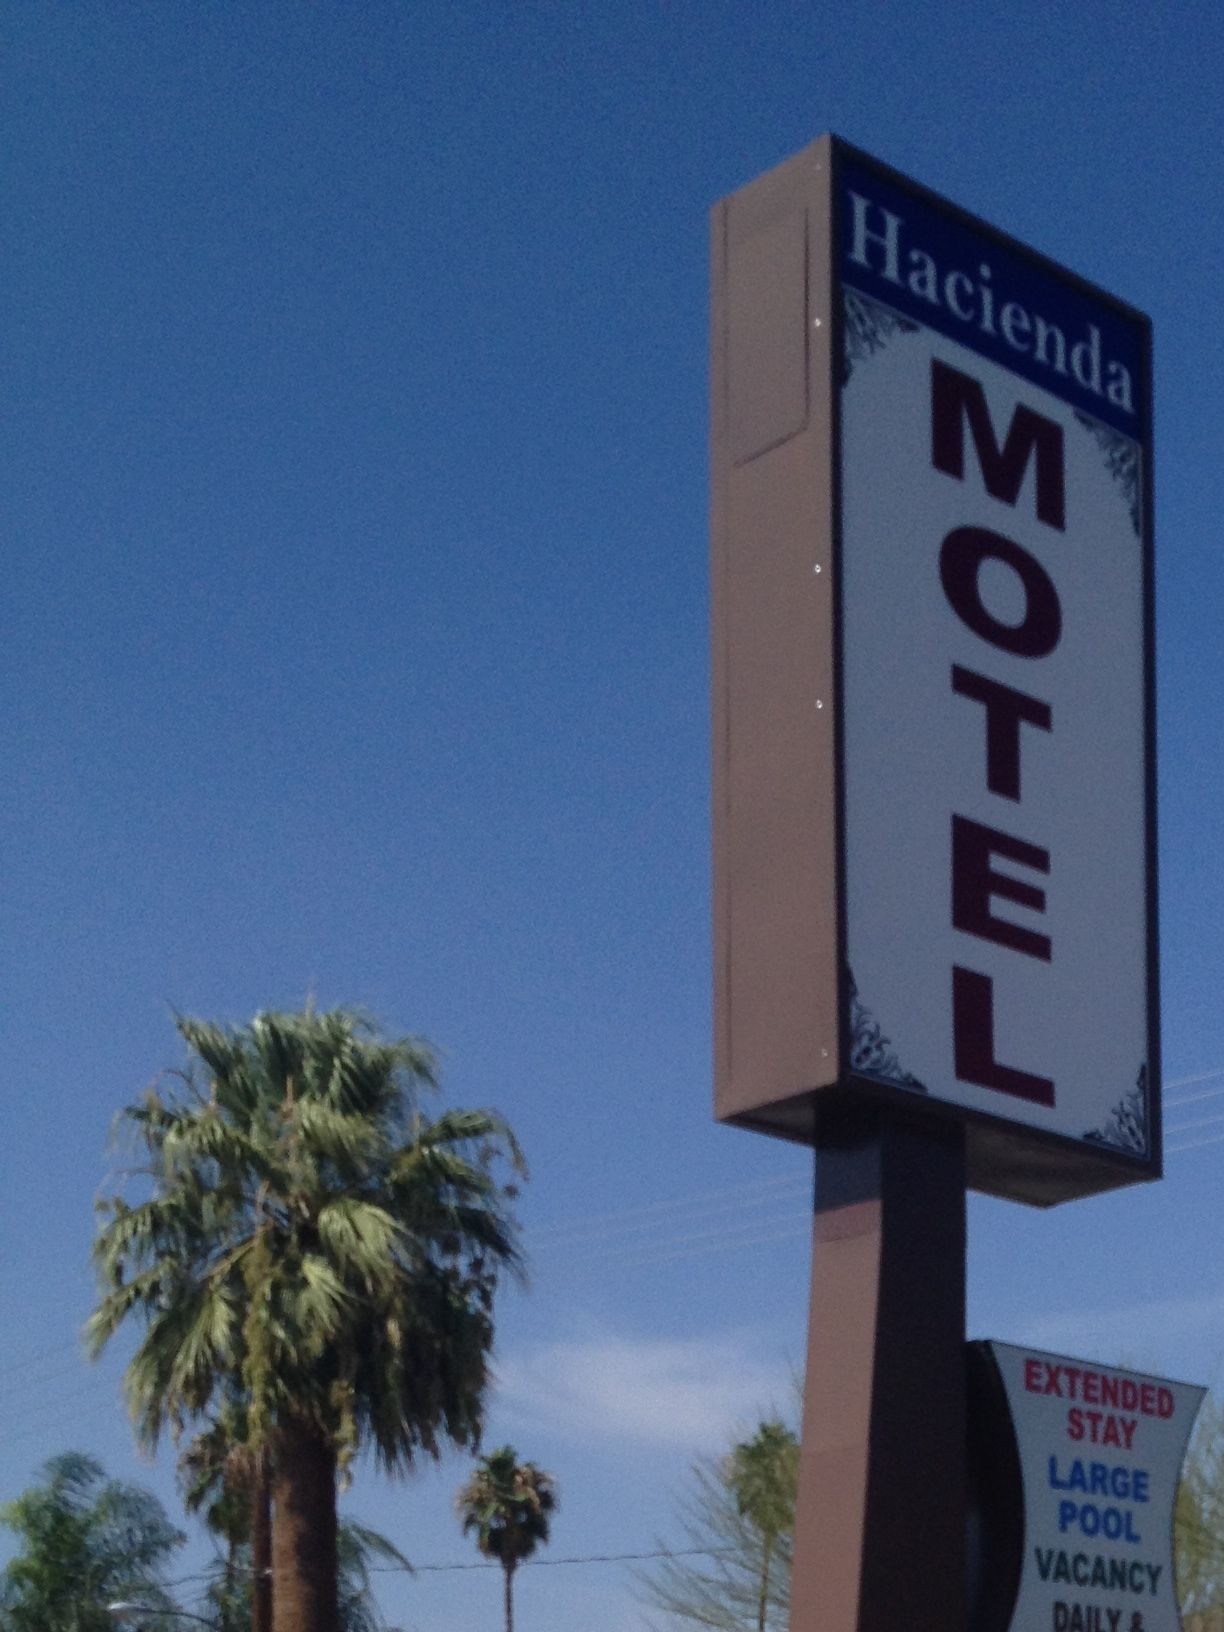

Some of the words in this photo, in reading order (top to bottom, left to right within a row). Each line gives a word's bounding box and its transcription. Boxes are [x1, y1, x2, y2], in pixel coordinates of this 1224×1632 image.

[848, 189, 1136, 415] Hacienda
[930, 356, 1066, 1108] MOTEL
[1024, 1357, 1176, 1420] EXTENDED
[1067, 1406, 1138, 1451] STAY
[1048, 1453, 1150, 1502] LARGE
[1058, 1500, 1141, 1544] POOL
[1034, 1547, 1163, 1596] VACANCY
